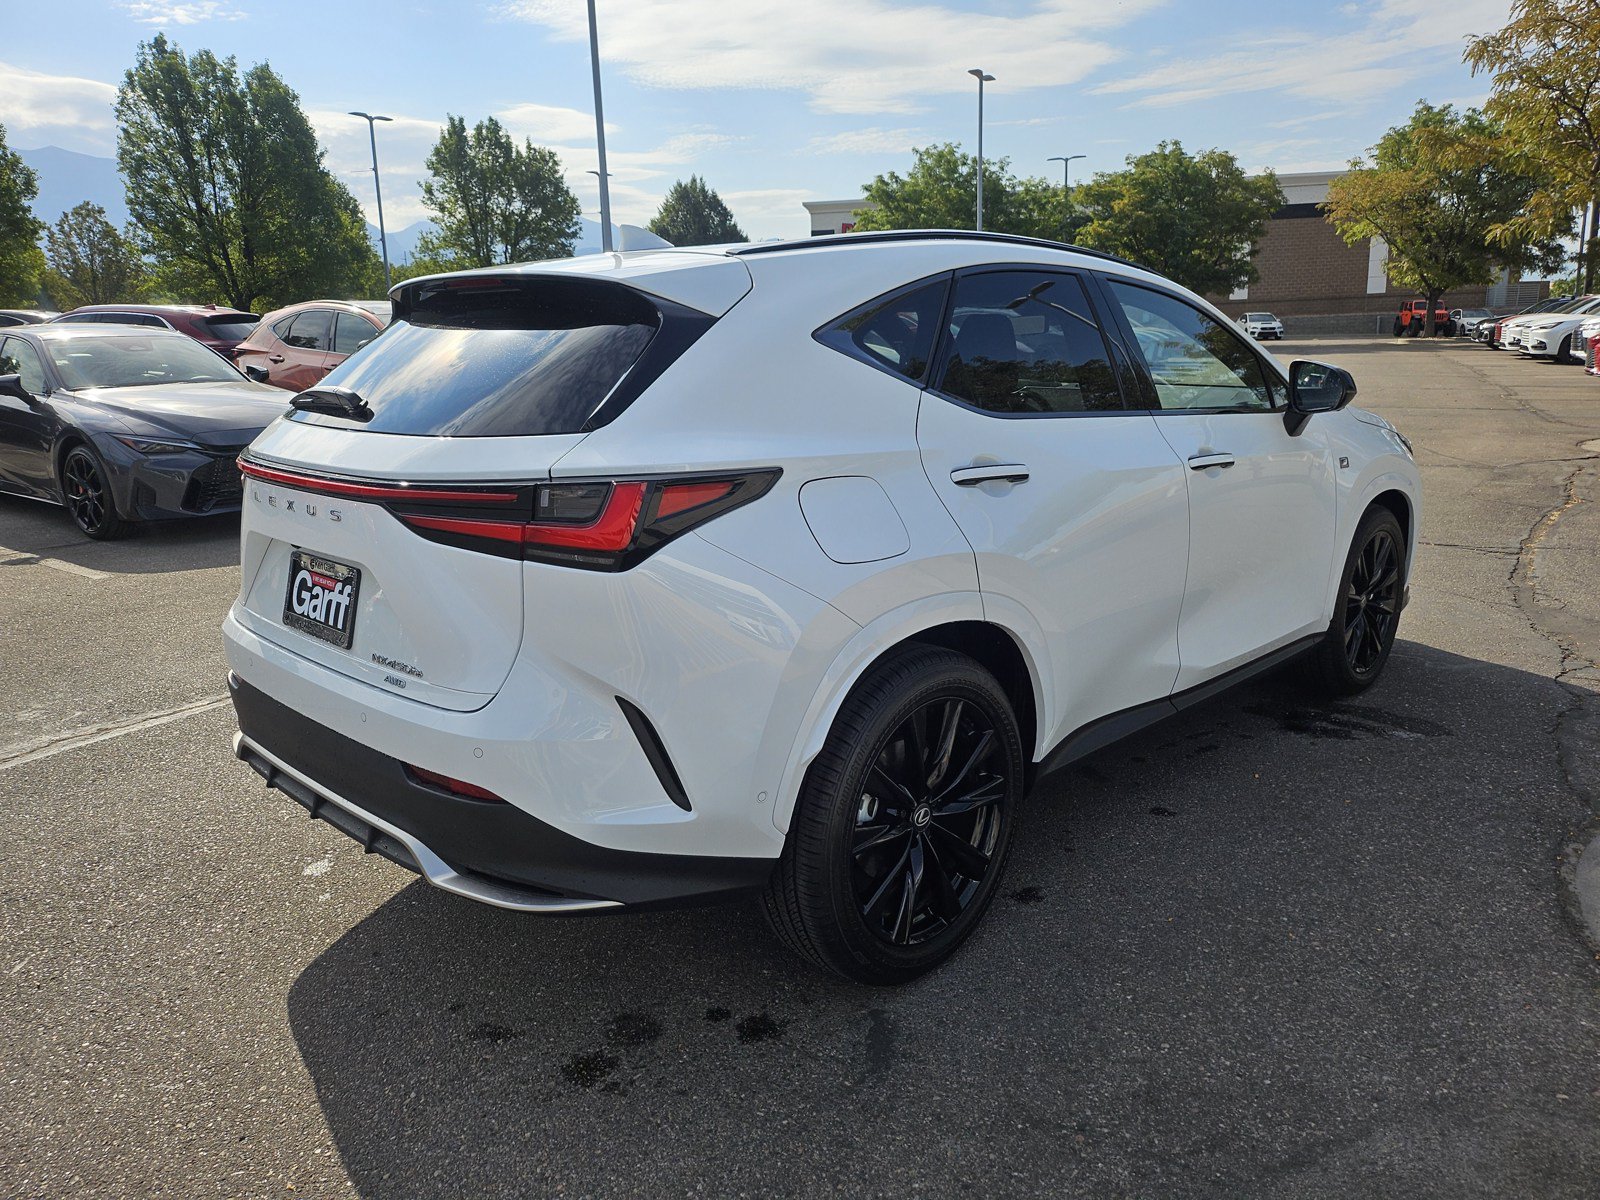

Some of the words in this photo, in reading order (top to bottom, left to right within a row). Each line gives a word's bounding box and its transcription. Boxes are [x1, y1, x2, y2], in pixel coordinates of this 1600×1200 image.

[254, 491, 342, 522] LEXUS
[293, 570, 351, 629] Garff
[383, 672, 407, 689] AWD
